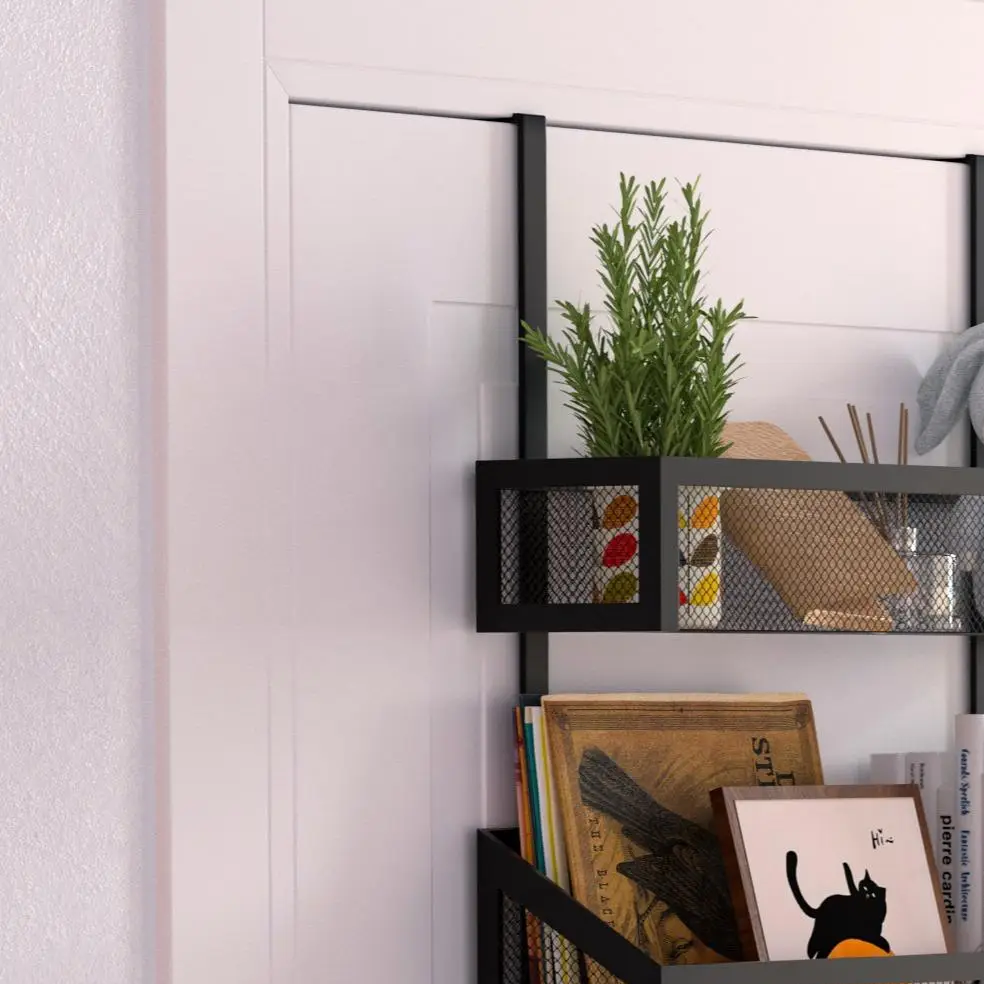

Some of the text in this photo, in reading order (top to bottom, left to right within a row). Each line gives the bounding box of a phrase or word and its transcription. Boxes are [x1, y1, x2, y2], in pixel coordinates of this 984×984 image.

[588, 817, 604, 852] THE
[940, 815, 955, 924] pierre cardin
